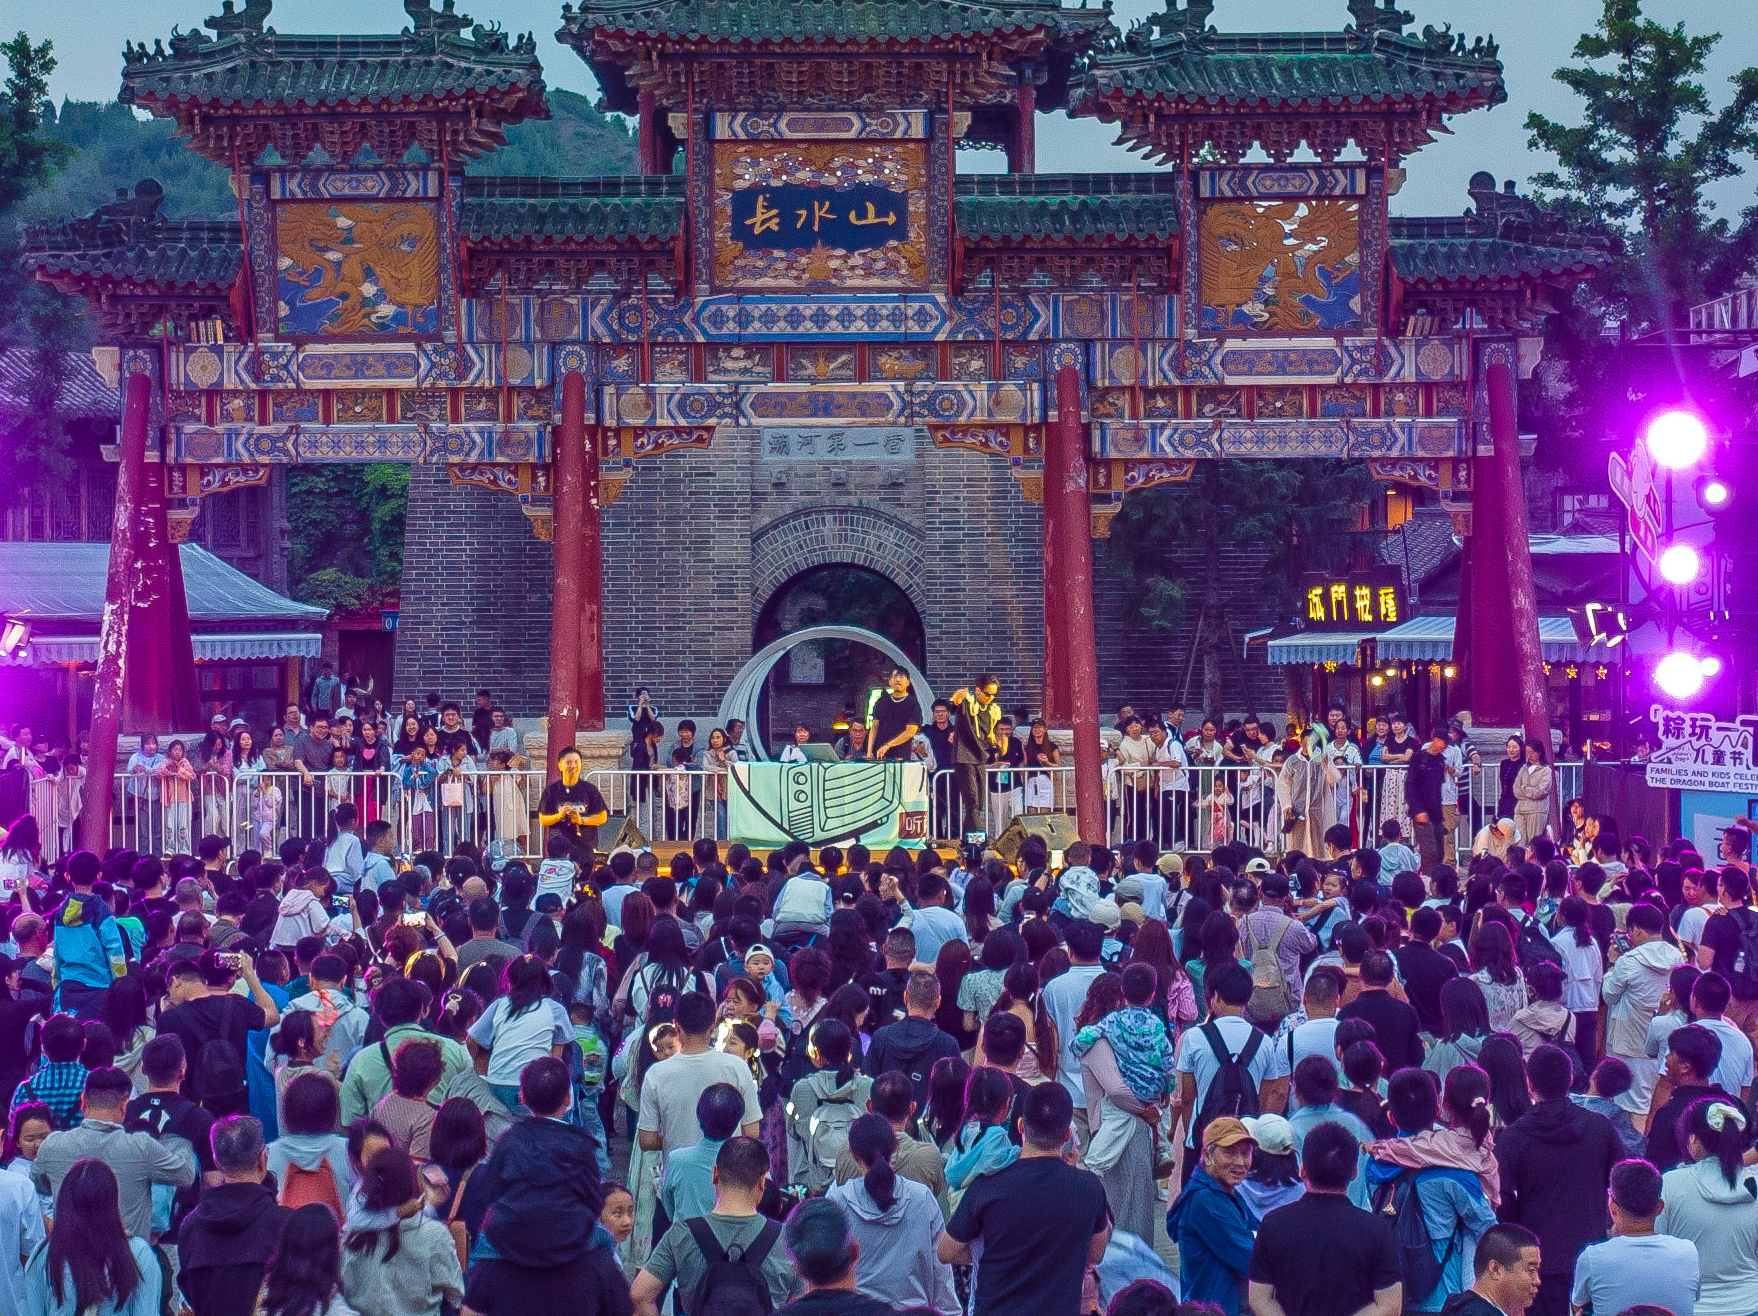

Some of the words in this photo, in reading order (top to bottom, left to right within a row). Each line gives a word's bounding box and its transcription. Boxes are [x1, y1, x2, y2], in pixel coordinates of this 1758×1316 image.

[1650, 766, 1689, 777] FAMILIES
[1691, 770, 1709, 778] AND
[1712, 771, 1731, 780] KIDS
[1650, 776, 1666, 785] THE
[1670, 778, 1706, 787] DRAGON
[1708, 780, 1730, 789] BOAT
